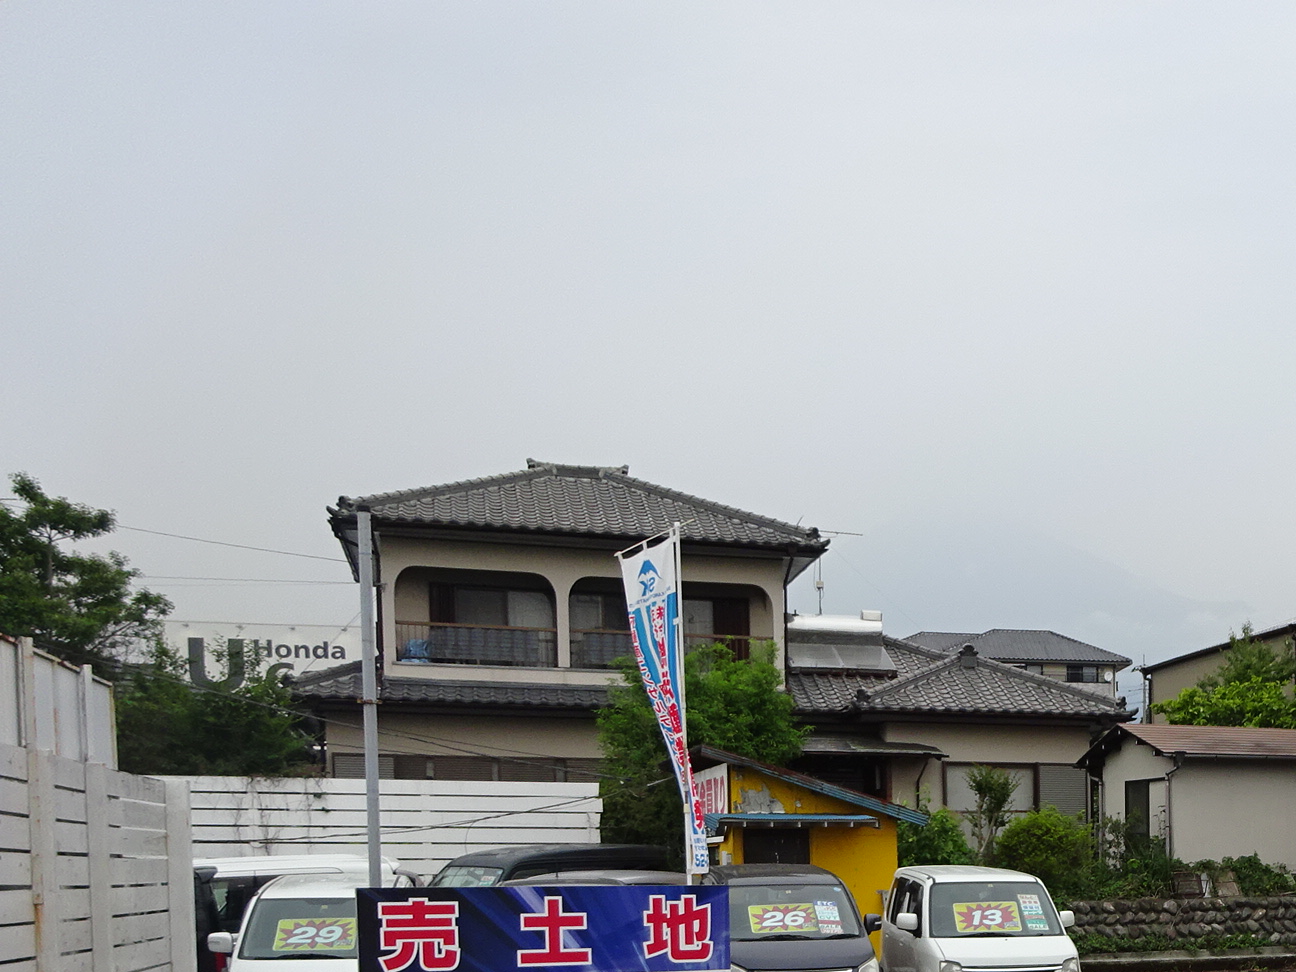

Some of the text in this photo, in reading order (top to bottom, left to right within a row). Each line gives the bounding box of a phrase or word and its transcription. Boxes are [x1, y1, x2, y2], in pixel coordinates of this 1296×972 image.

[252, 639, 346, 660] Honda
[762, 910, 806, 926] 26
[972, 909, 1003, 925] 13
[286, 925, 343, 944] 29
